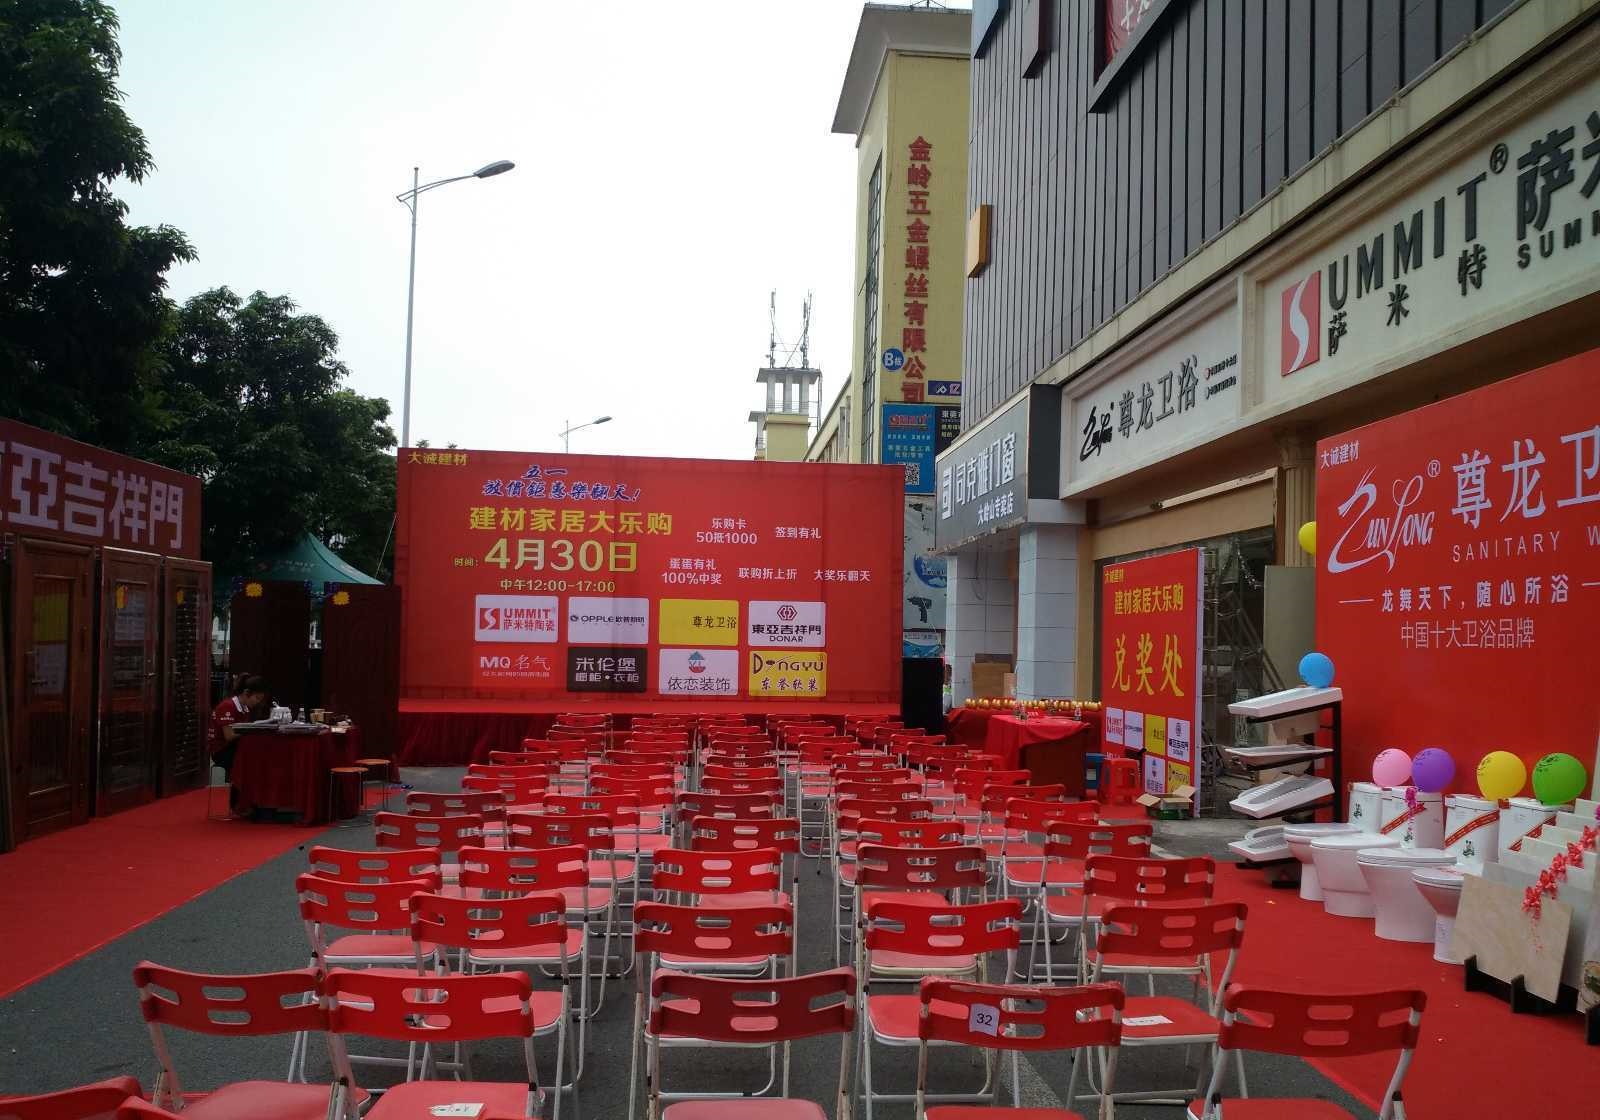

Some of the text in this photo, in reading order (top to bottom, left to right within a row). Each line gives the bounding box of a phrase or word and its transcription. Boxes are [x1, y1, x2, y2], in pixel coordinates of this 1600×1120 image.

[1118, 355, 1198, 438] 尊龙卫浴
[408, 451, 468, 466] 大诚建材
[1320, 440, 1359, 471] 大诚建材
[521, 464, 567, 480] 五一
[0, 441, 184, 549] 亞吉祥門
[469, 507, 672, 535] 建材家居大乐购
[711, 518, 747, 529] 乐购卡
[696, 531, 757, 545] 50抵1000
[775, 526, 821, 539] 签到有礼
[1452, 530, 1560, 562] SANITARY
[484, 538, 637, 572] 4月30日
[661, 572, 722, 585] 100%中奖
[738, 567, 797, 580] 联购折上折
[813, 569, 871, 582] 大奖乐翻天
[1115, 583, 1184, 614] 建材家居大乐购
[503, 620, 555, 631] 萨米特陶瓷
[581, 615, 614, 623] OPPLE
[693, 616, 736, 629] 尊龙卫浴
[752, 624, 821, 636] 東亞吉祥門
[1400, 618, 1535, 649] 中国十大卫浴品牌
[516, 655, 550, 670] 名气
[576, 657, 636, 672] 米伦堡
[1112, 632, 1184, 696] 兑奖处
[668, 677, 730, 692] 依恋装饰
[761, 677, 817, 692] 东誉软装
[976, 1012, 992, 1026] 32
